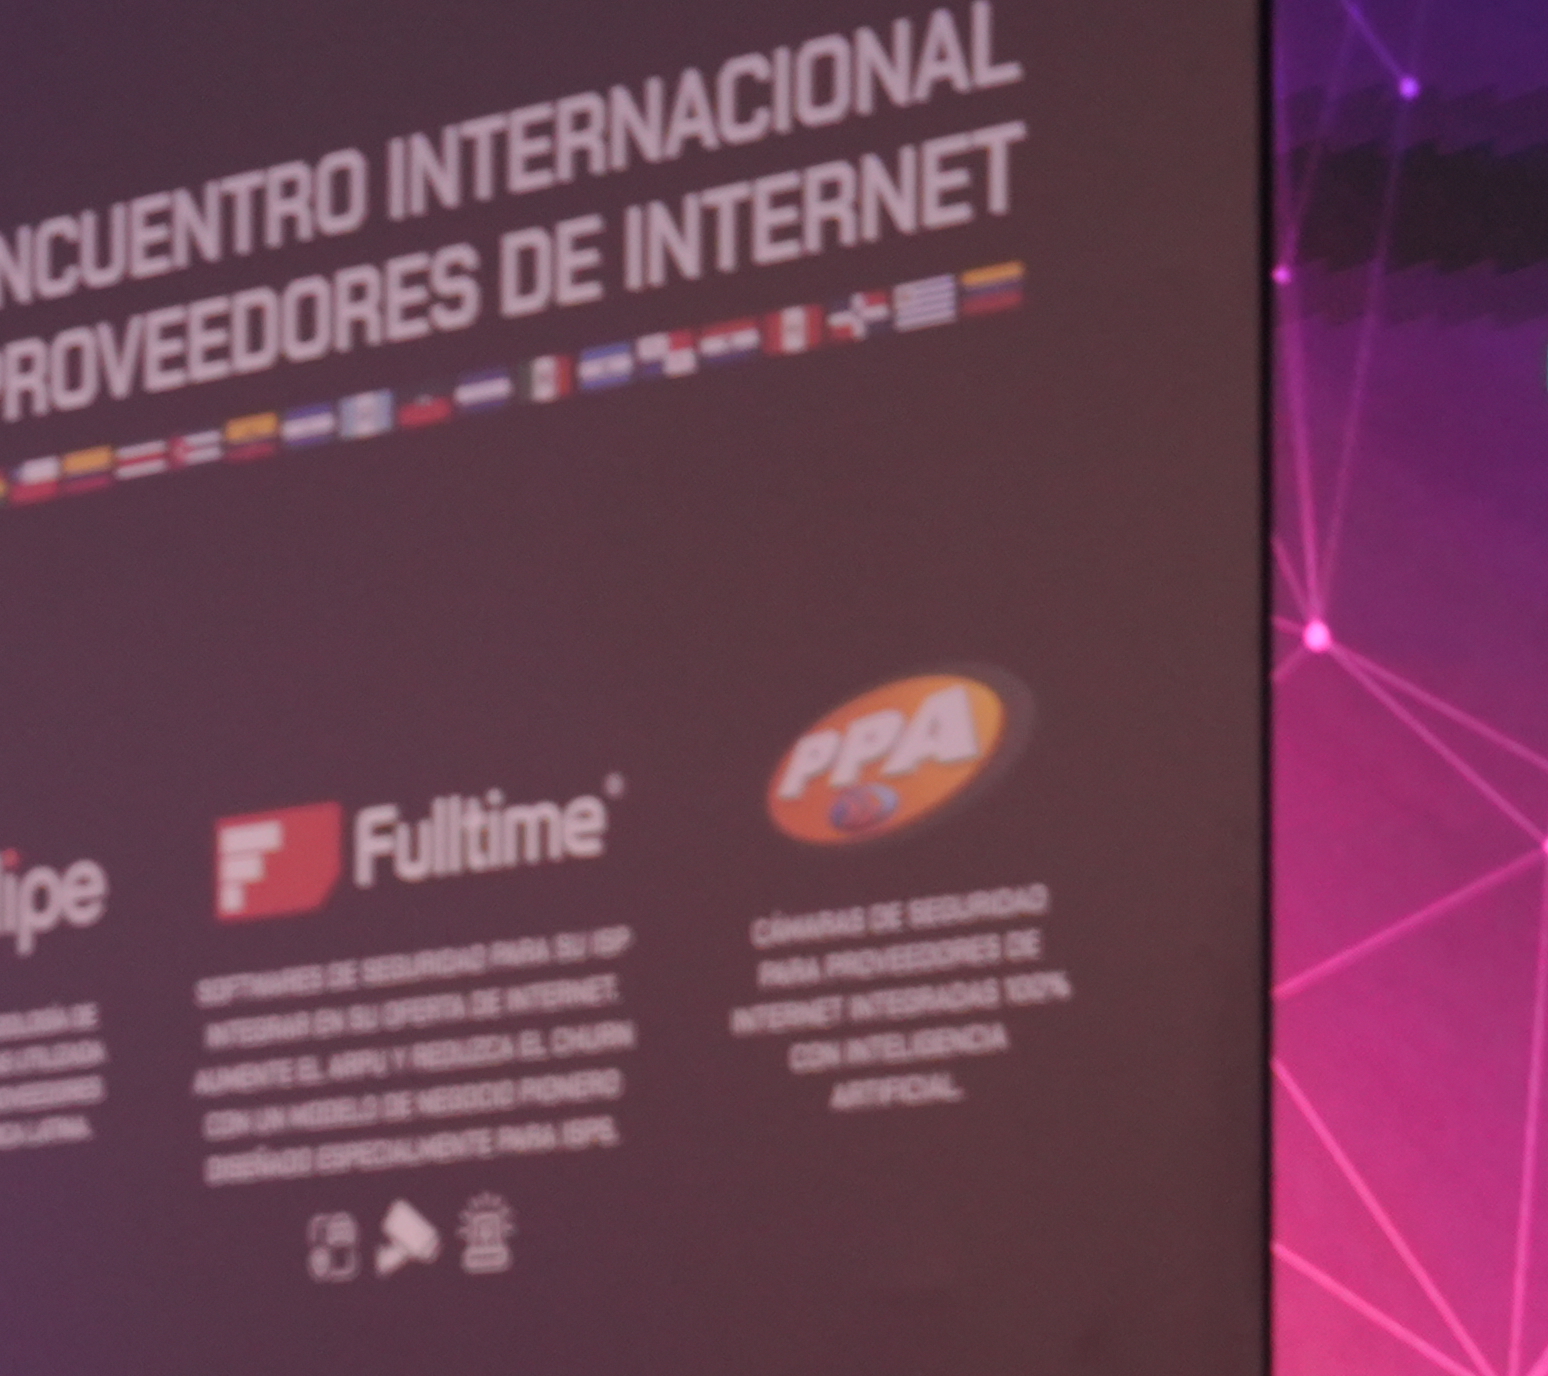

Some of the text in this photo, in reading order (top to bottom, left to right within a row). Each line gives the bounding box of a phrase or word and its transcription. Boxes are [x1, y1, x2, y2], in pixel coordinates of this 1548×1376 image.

[388, 2, 1022, 220] INTERNACIONAL
[501, 214, 603, 317] DE
[625, 121, 1026, 290] INTERNET
[776, 684, 984, 800] PPA
[353, 786, 610, 889] Fulltime
